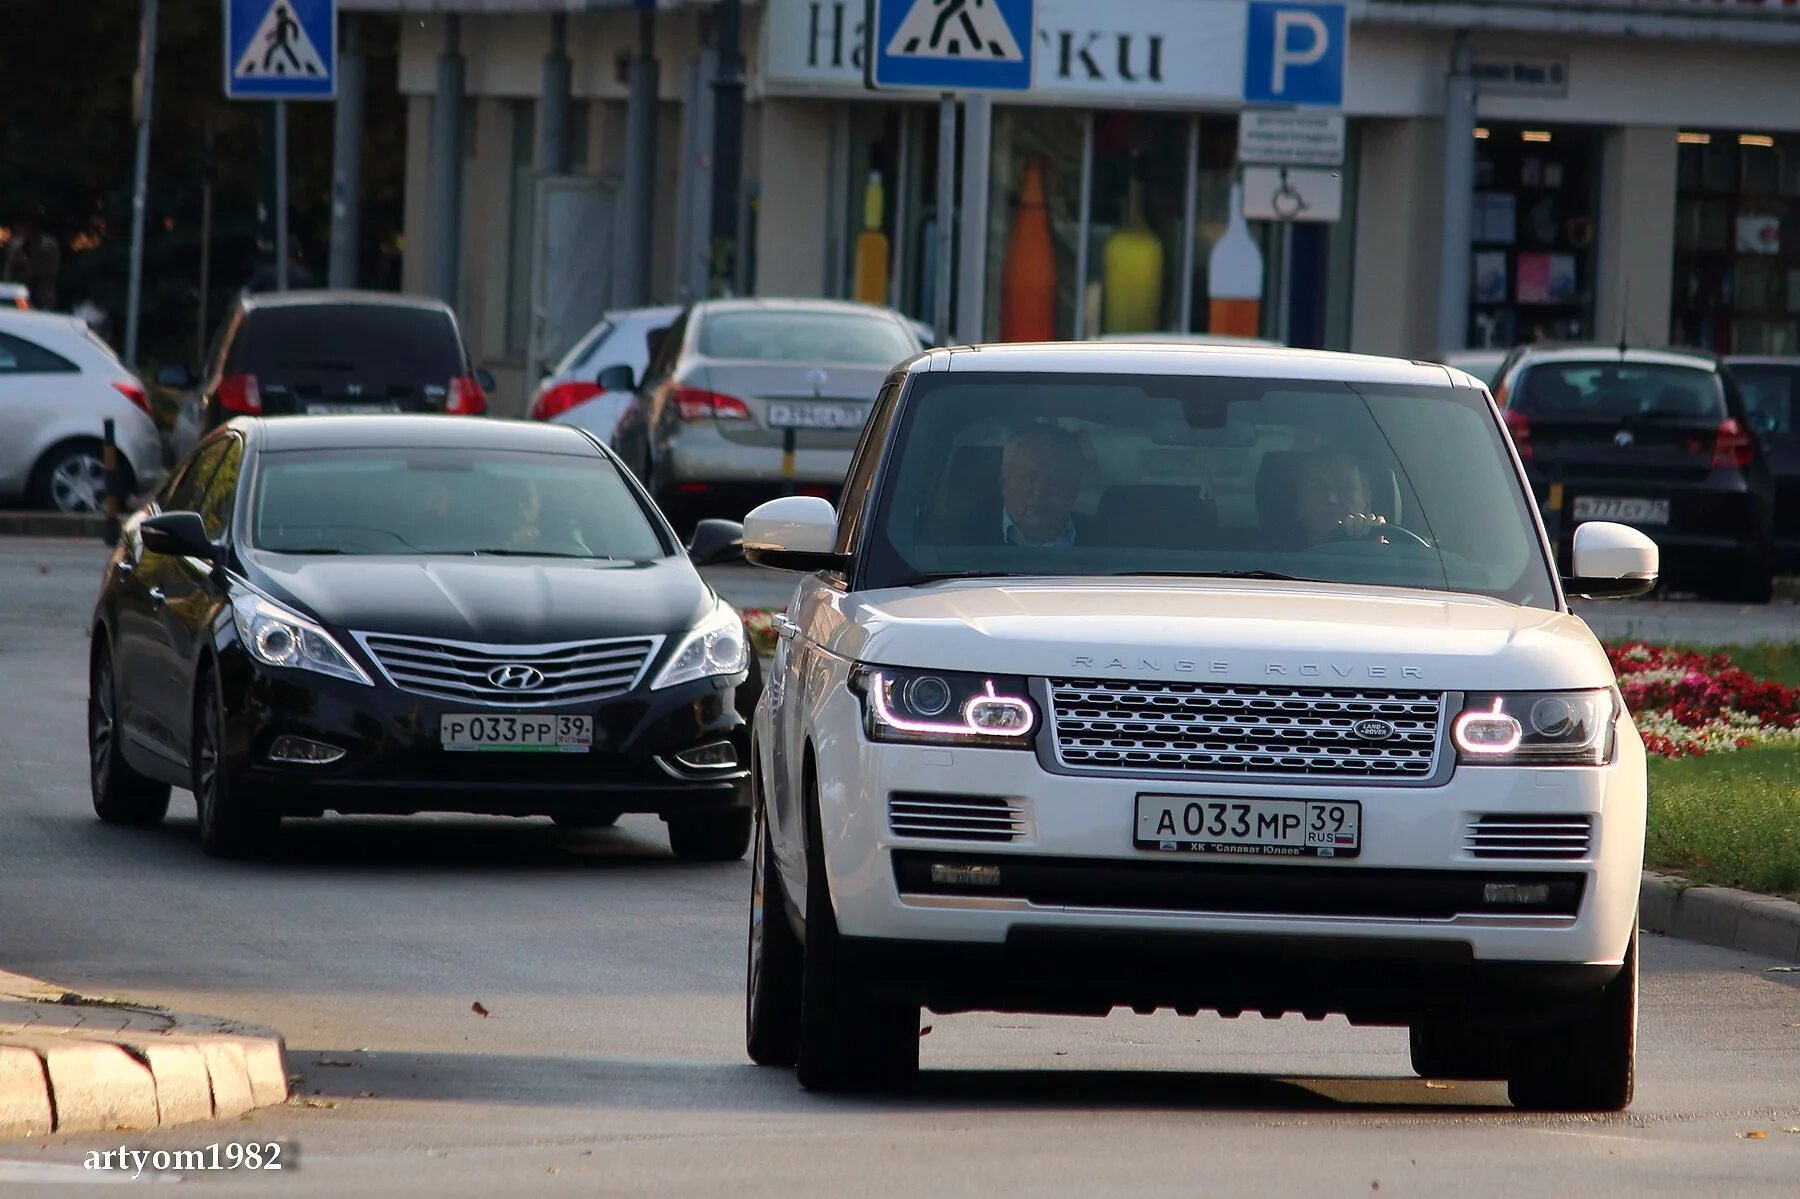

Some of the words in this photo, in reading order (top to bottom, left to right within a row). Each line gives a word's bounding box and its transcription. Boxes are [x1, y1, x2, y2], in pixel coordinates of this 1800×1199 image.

[1271, 10, 1329, 94] P
[1072, 656, 1229, 674] RANGE
[1265, 663, 1423, 679] ROVER
[559, 717, 585, 736] 39
[1156, 802, 1301, 839] А033МР
[1310, 805, 1345, 832] 39
[1308, 831, 1334, 843] RUS
